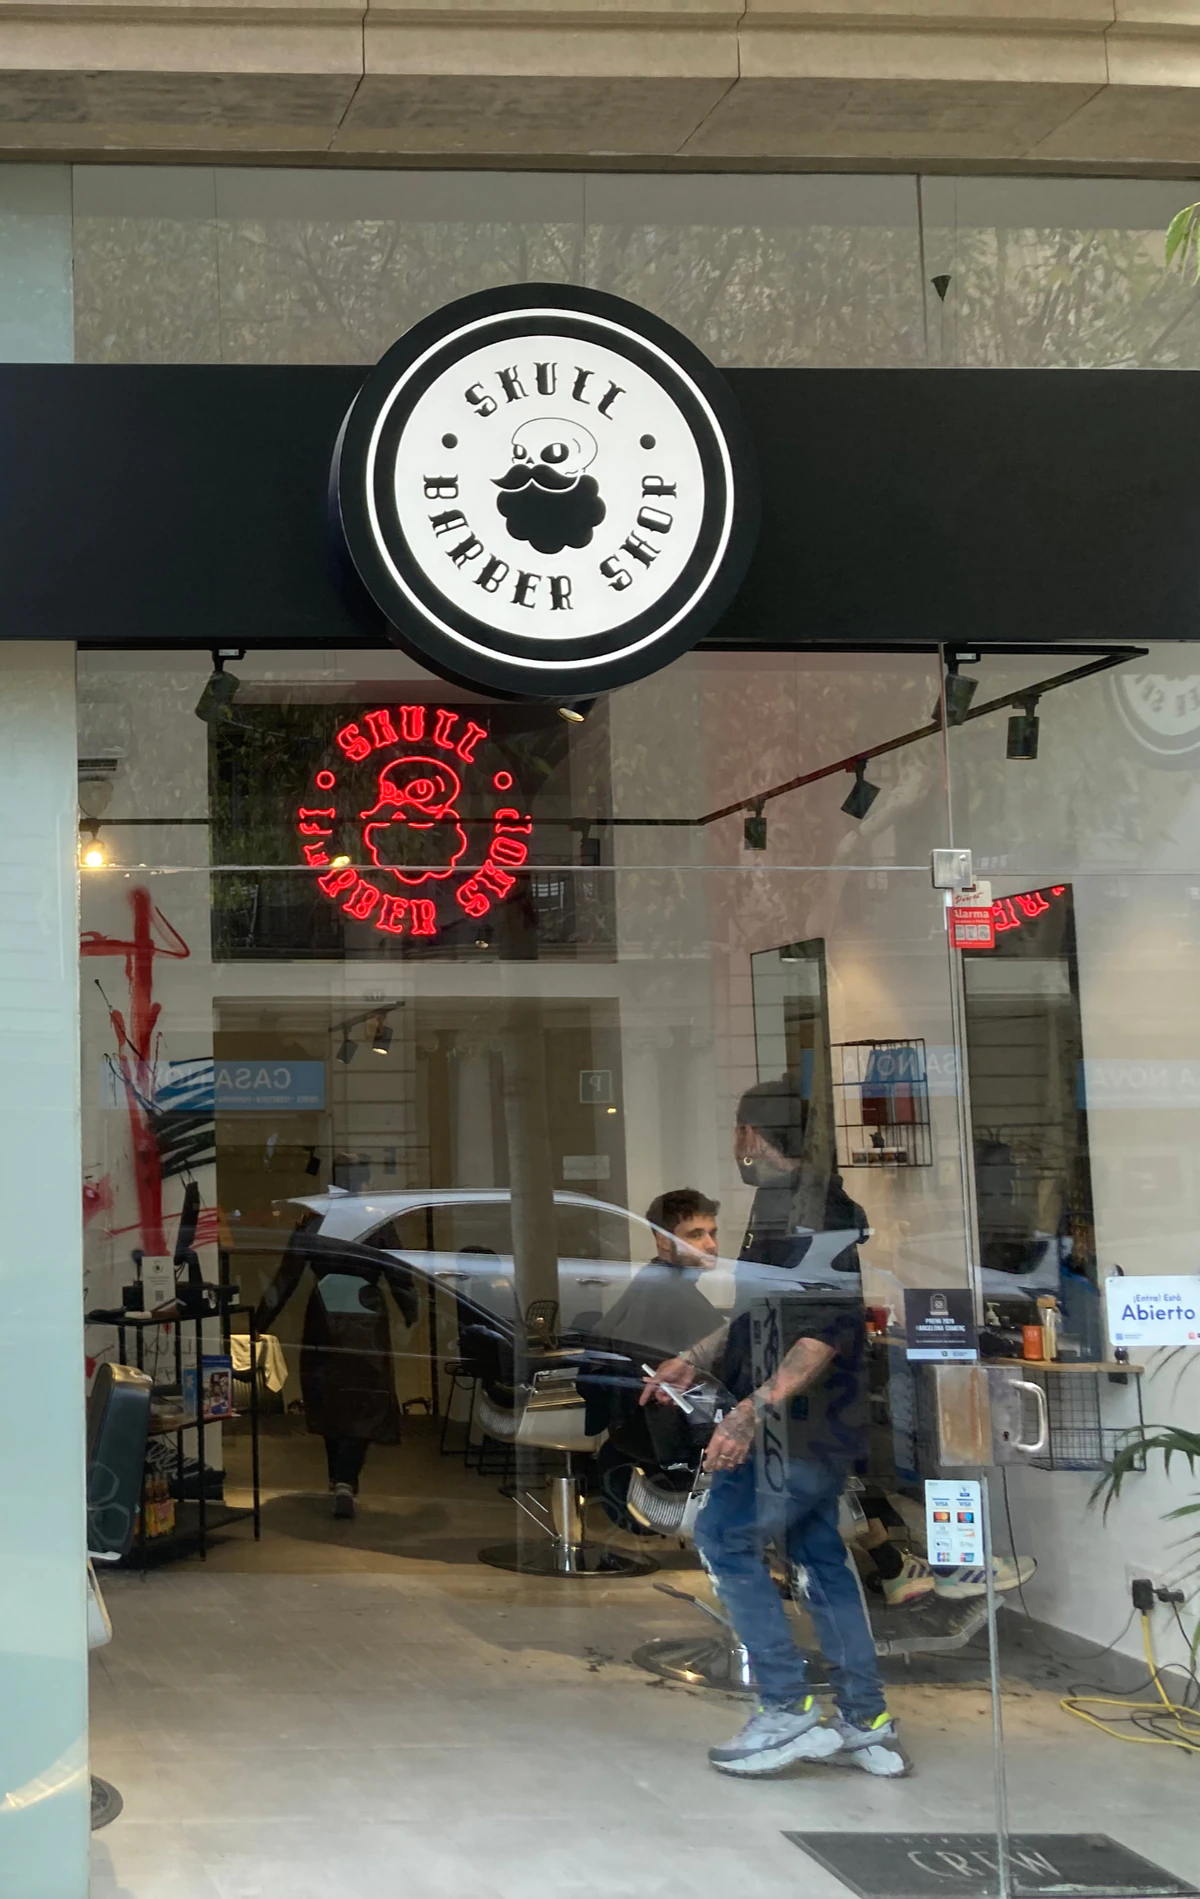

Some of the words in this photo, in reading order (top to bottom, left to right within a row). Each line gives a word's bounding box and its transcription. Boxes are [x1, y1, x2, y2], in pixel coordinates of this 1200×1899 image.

[464, 362, 626, 420] SKULL
[423, 473, 574, 610] BARBER
[599, 474, 677, 592] SHOP
[337, 706, 487, 763] SKULL
[456, 808, 532, 917] SHOP
[1121, 1304, 1196, 1320] Abierto
